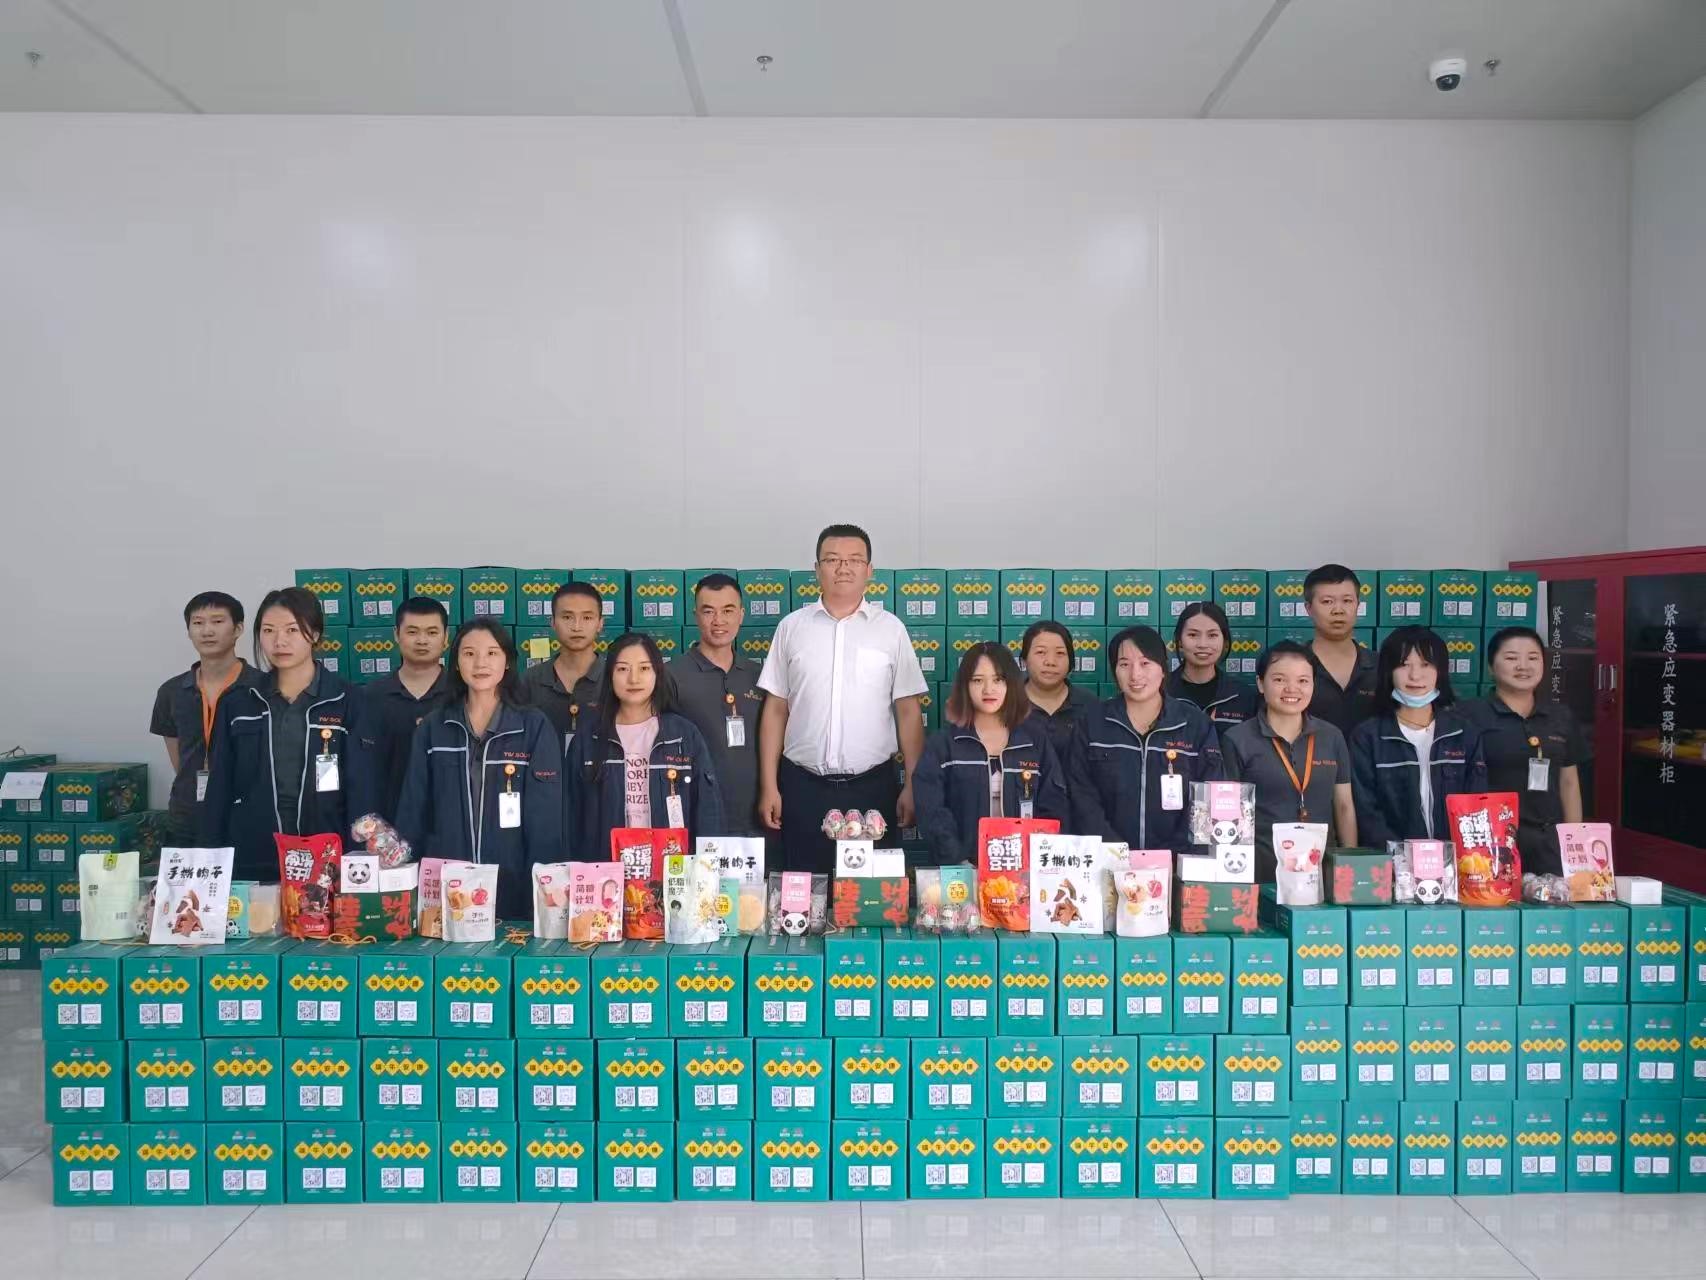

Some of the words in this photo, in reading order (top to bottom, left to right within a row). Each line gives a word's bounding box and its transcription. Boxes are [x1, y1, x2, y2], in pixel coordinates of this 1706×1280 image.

[1659, 603, 1679, 784] 紧急应变器材柜
[719, 856, 757, 869] 撕肉干
[1040, 853, 1099, 869] 手撕肉干
[168, 865, 223, 880] 手撕肉干
[53, 980, 105, 992] 端午安康
[135, 979, 186, 992] 端午安康
[214, 976, 265, 988] 端午安康
[293, 977, 345, 989] 端午安康
[371, 977, 420, 989] 端午安康
[446, 978, 497, 991] 端午安康
[526, 980, 577, 993] 端午安康
[604, 979, 655, 991] 端午安康
[680, 977, 730, 990] 端午安康
[760, 978, 810, 990] 端午安康
[57, 1063, 107, 1075] 端午安康
[141, 1063, 190, 1075] 端午安康
[218, 1061, 268, 1074] 端午安康
[296, 1061, 345, 1075] 端午安康
[375, 1060, 425, 1073] 端午安康
[451, 1064, 501, 1075] 端午安康
[529, 1061, 579, 1074] 端午安康
[611, 1062, 661, 1075] 端午安康
[690, 1060, 740, 1074] 端午安康
[768, 1062, 818, 1075] 端午安康
[847, 1060, 897, 1072] 端午安康
[924, 1060, 974, 1073] 端午安康
[999, 1058, 1049, 1070] 端午安康
[1076, 1059, 1125, 1071] 端午安康
[1151, 1058, 1201, 1069] 端午安康
[1229, 1058, 1277, 1070] 端午安康
[142, 1145, 193, 1158] 端午安康
[299, 1144, 348, 1157] 端午安康
[376, 1144, 426, 1156] 端午安康
[455, 1142, 503, 1155] 端午安康
[531, 1143, 580, 1156] 端午安康
[610, 1143, 659, 1156] 端午安康
[689, 1143, 739, 1155] 端午安康
[766, 1144, 816, 1156] 端午安康
[845, 1142, 894, 1154] 端午安康
[922, 1141, 971, 1153] 端午安康
[998, 1139, 1047, 1152] 端午安康
[1075, 1139, 1124, 1152] 端午安康
[1151, 1141, 1200, 1152] 端午安康
[1228, 1140, 1277, 1152] 端午安康
[64, 1146, 116, 1160] 端午安康
[219, 1146, 269, 1159] 端午安康
